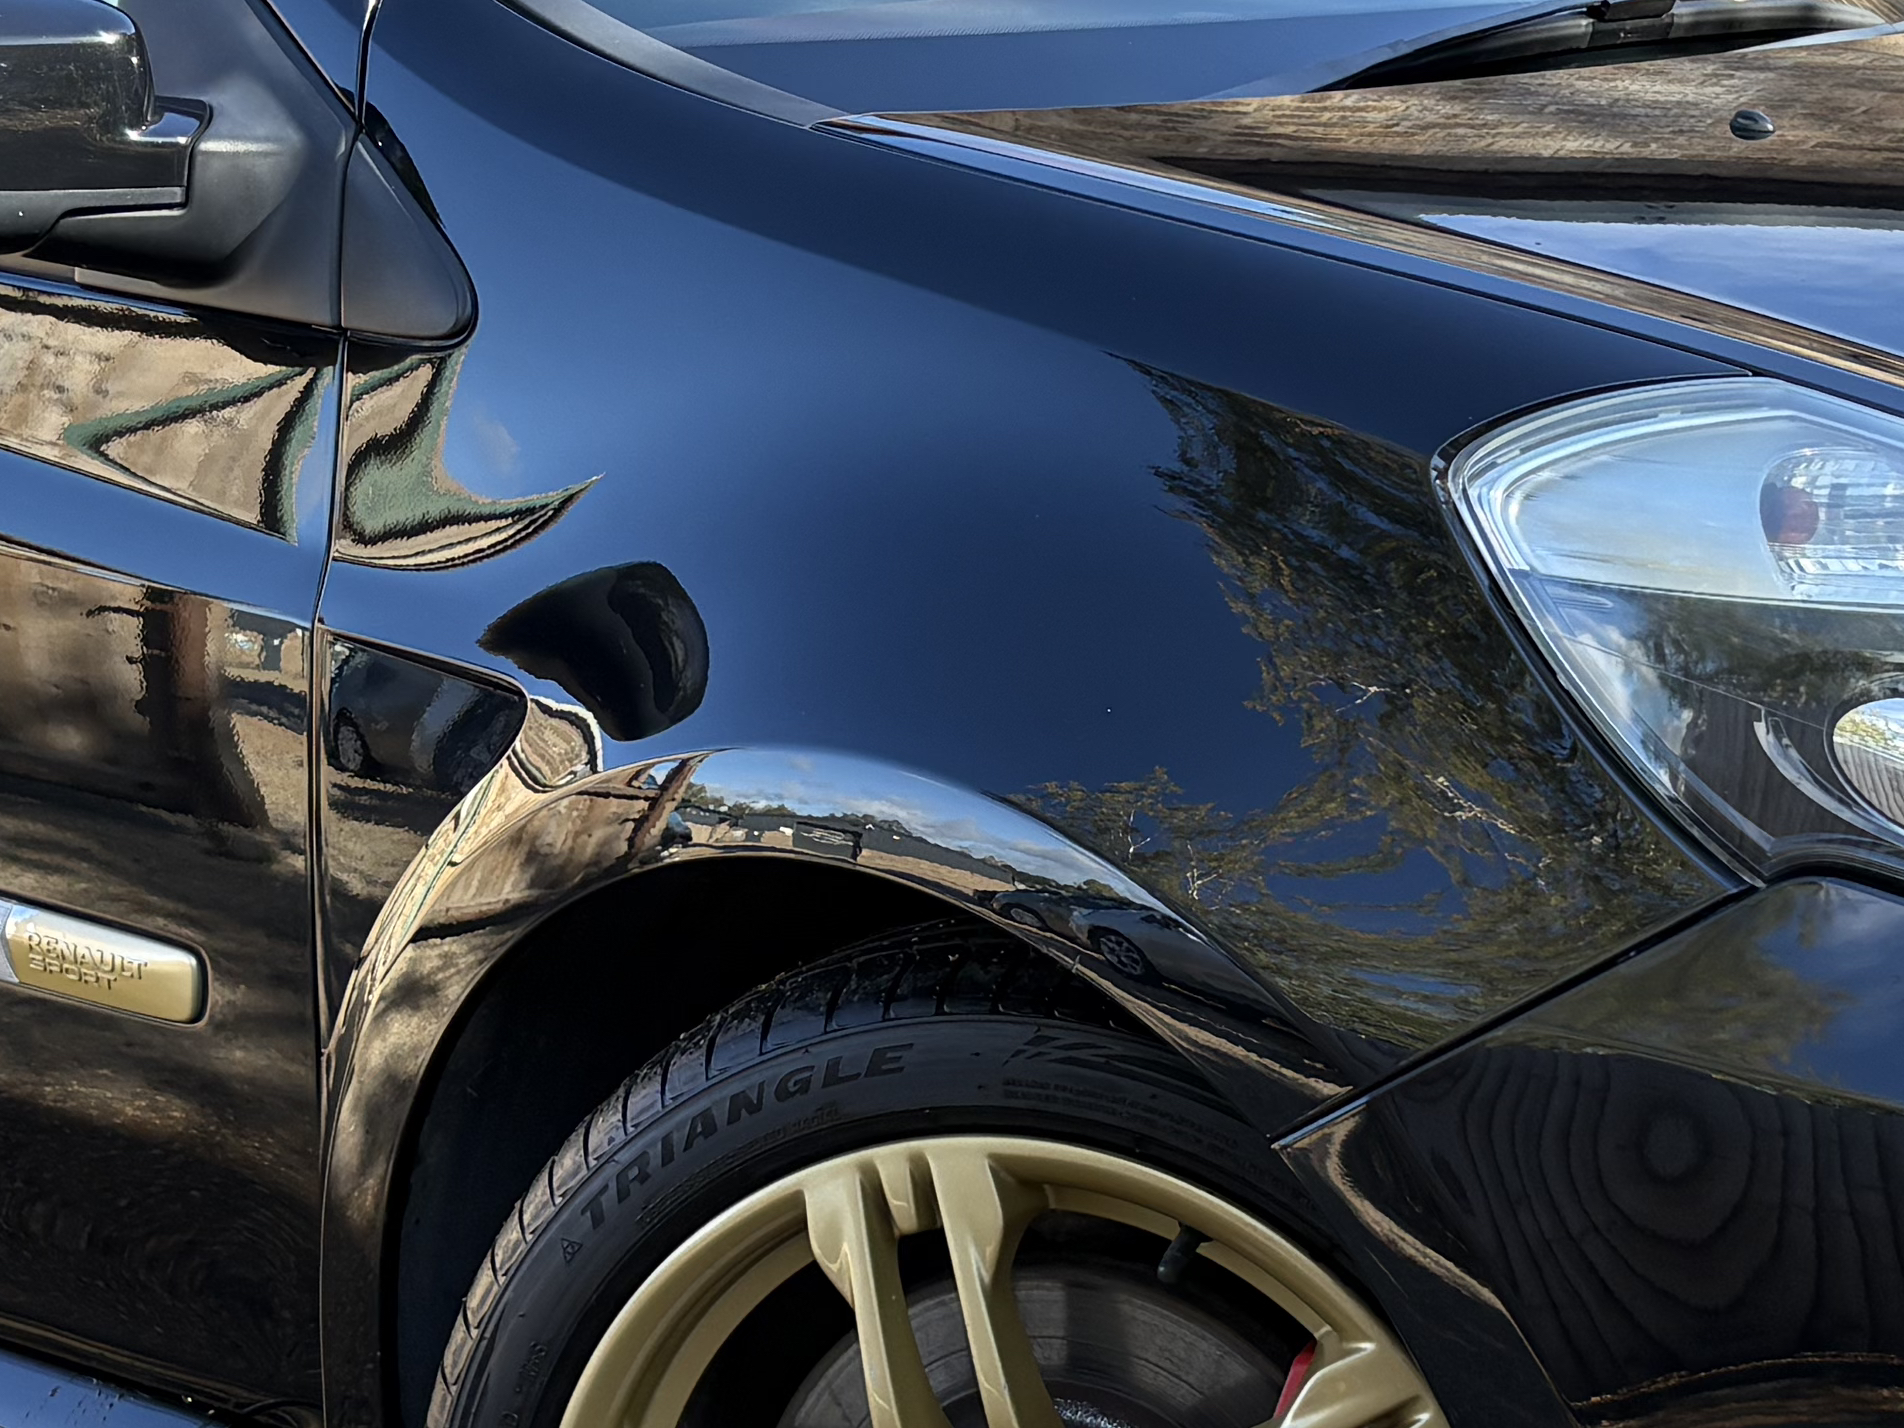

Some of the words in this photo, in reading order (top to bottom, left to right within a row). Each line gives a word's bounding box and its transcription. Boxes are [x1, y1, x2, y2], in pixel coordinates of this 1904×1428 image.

[26, 930, 148, 980] RENAULT
[28, 952, 117, 990] SPORT
[580, 1042, 914, 1232] TRIANGLE
